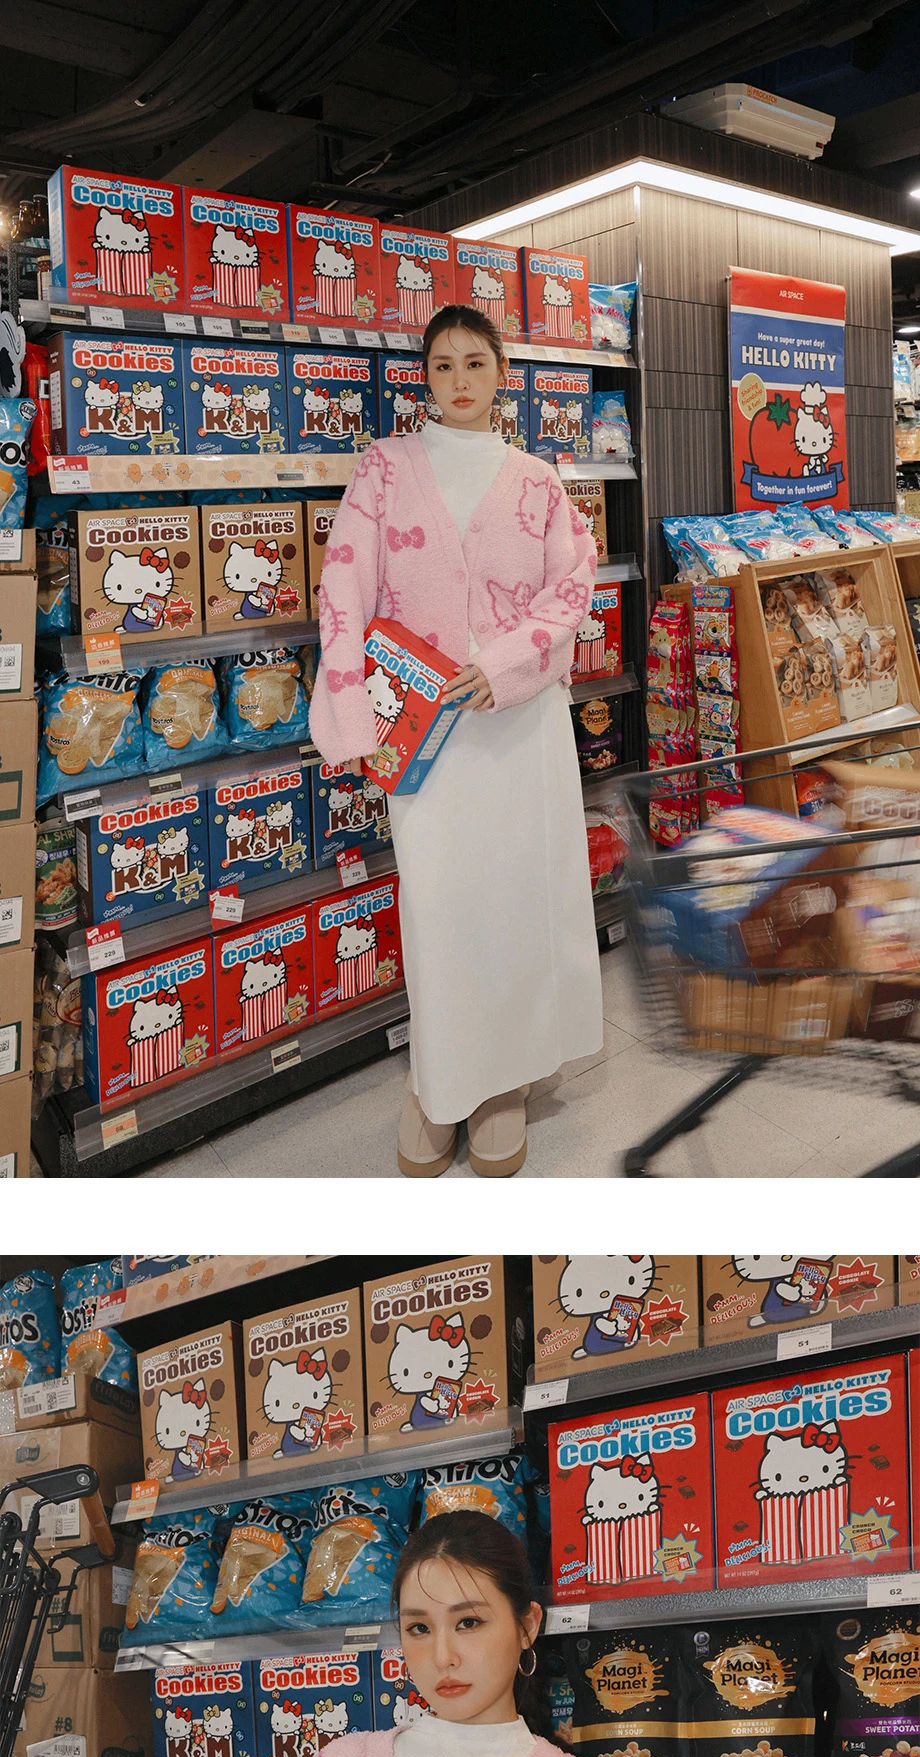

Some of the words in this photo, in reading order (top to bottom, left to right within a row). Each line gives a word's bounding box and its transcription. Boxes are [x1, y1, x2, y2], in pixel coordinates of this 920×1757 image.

[73, 185, 173, 215] Cookies
[123, 183, 146, 194] HELLO
[149, 187, 173, 198] KITTY
[192, 204, 278, 231] Cookies
[297, 221, 372, 246] Cookies
[383, 237, 448, 260] Cookies
[788, 291, 804, 300] SPACE
[125, 345, 147, 354] HELLO
[149, 346, 173, 354] KITTY
[758, 332, 773, 342] Have
[780, 337, 795, 346] super
[796, 338, 812, 347] great
[814, 339, 825, 349] day!
[74, 353, 173, 372] Cookies
[194, 357, 279, 376] Cookies
[742, 346, 790, 367] HELLO
[794, 352, 836, 371] KITTY
[295, 362, 369, 380] Cookies
[535, 377, 588, 393] Cookies
[757, 482, 786, 495] Together
[787, 487, 793, 495] in
[794, 486, 805, 495] fun
[806, 481, 832, 494] forever!
[89, 526, 189, 545] Cookies
[211, 520, 295, 537] Cookies
[365, 638, 439, 700] Cookies
[407, 655, 426, 674] HELLO
[423, 665, 446, 684] KITTY
[101, 797, 197, 833] Cookies
[104, 950, 117, 958] 229
[108, 961, 205, 1007] Cookies
[427, 1272, 456, 1285] HELLO
[458, 1264, 490, 1278] KITTY
[373, 1279, 490, 1323] Cookies
[250, 1318, 348, 1357] Cookies
[797, 1340, 809, 1348] 51
[143, 1350, 223, 1388] Cookies
[747, 1391, 781, 1408] SPACE
[805, 1380, 843, 1395] HELLO
[846, 1372, 888, 1388] KITTY
[730, 1389, 889, 1437] Cookies
[574, 1426, 603, 1440] SPACE
[622, 1416, 655, 1430] HELLO
[658, 1409, 693, 1422] KITTY
[559, 1424, 693, 1467] Cookies
[262, 1666, 359, 1690] Cookies
[601, 1663, 643, 1680] Magi
[597, 1678, 647, 1692] Planet
[56, 1717, 73, 1731] #8
[731, 1727, 752, 1735] CORN
[754, 1726, 776, 1734] SOUP
[865, 1726, 888, 1734] SWEET
